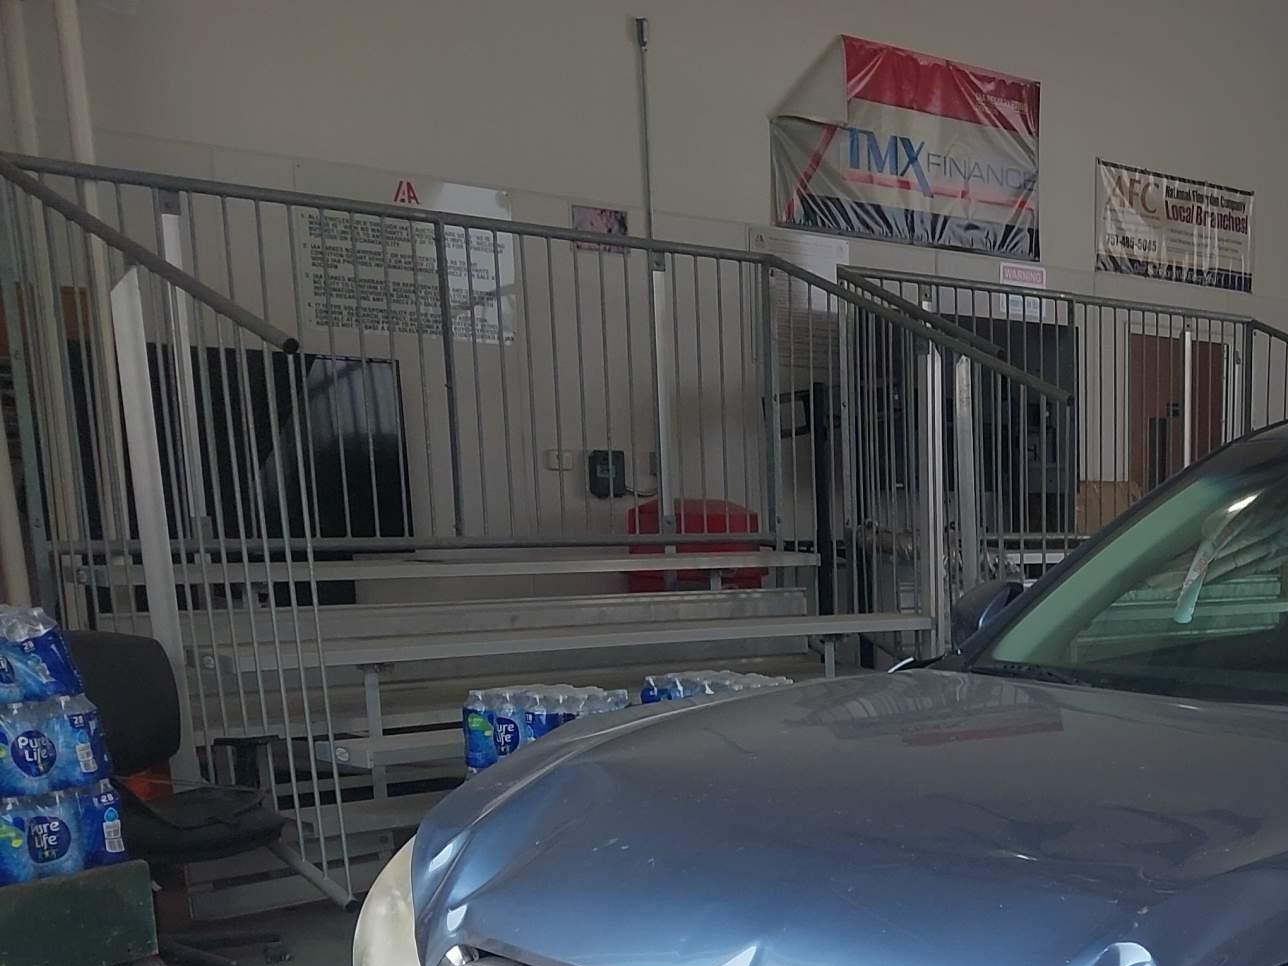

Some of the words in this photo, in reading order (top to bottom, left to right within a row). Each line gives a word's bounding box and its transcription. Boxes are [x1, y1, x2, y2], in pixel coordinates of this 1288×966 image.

[844, 126, 933, 198] TMX
[1165, 199, 1194, 225] Local
[1003, 267, 1042, 283] WARNING
[72, 715, 84, 724] 28
[496, 723, 515, 734] ure
[17, 736, 48, 749] Pure
[24, 748, 48, 765] Life
[30, 820, 61, 836] Pure
[34, 833, 58, 850] Life
